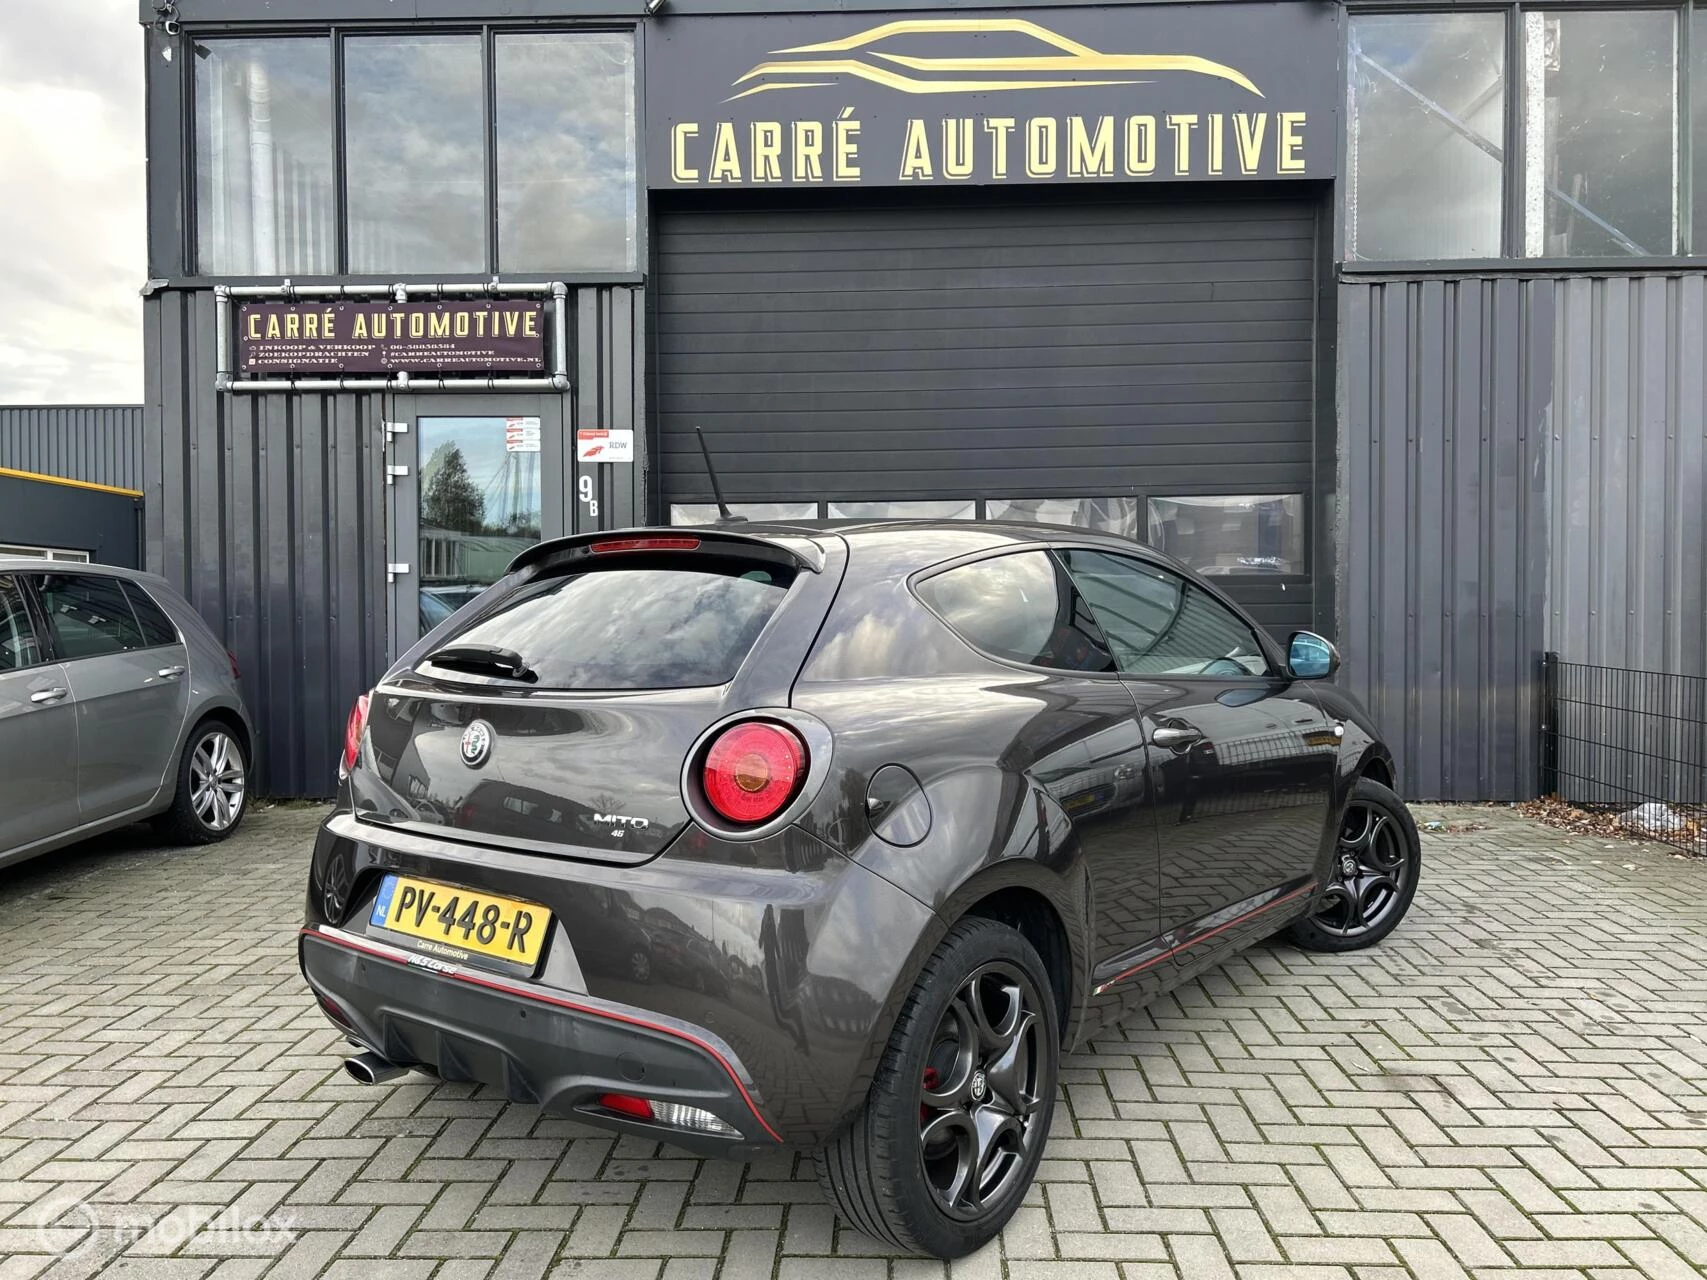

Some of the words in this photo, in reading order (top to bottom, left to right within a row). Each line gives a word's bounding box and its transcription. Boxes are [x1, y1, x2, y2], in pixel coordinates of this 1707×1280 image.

[671, 106, 861, 183] CARRÉ
[899, 111, 1307, 181] AUTOMOTIVE
[247, 308, 336, 340] CARRÉ
[352, 310, 539, 340] AUTOMOTIVE
[608, 441, 628, 449] RDW
[578, 475, 593, 503] 9
[589, 500, 598, 517] B
[593, 813, 649, 829] MITO
[375, 904, 386, 918] NL
[394, 886, 533, 954] PV-448-R
[433, 943, 469, 961] Automotive
